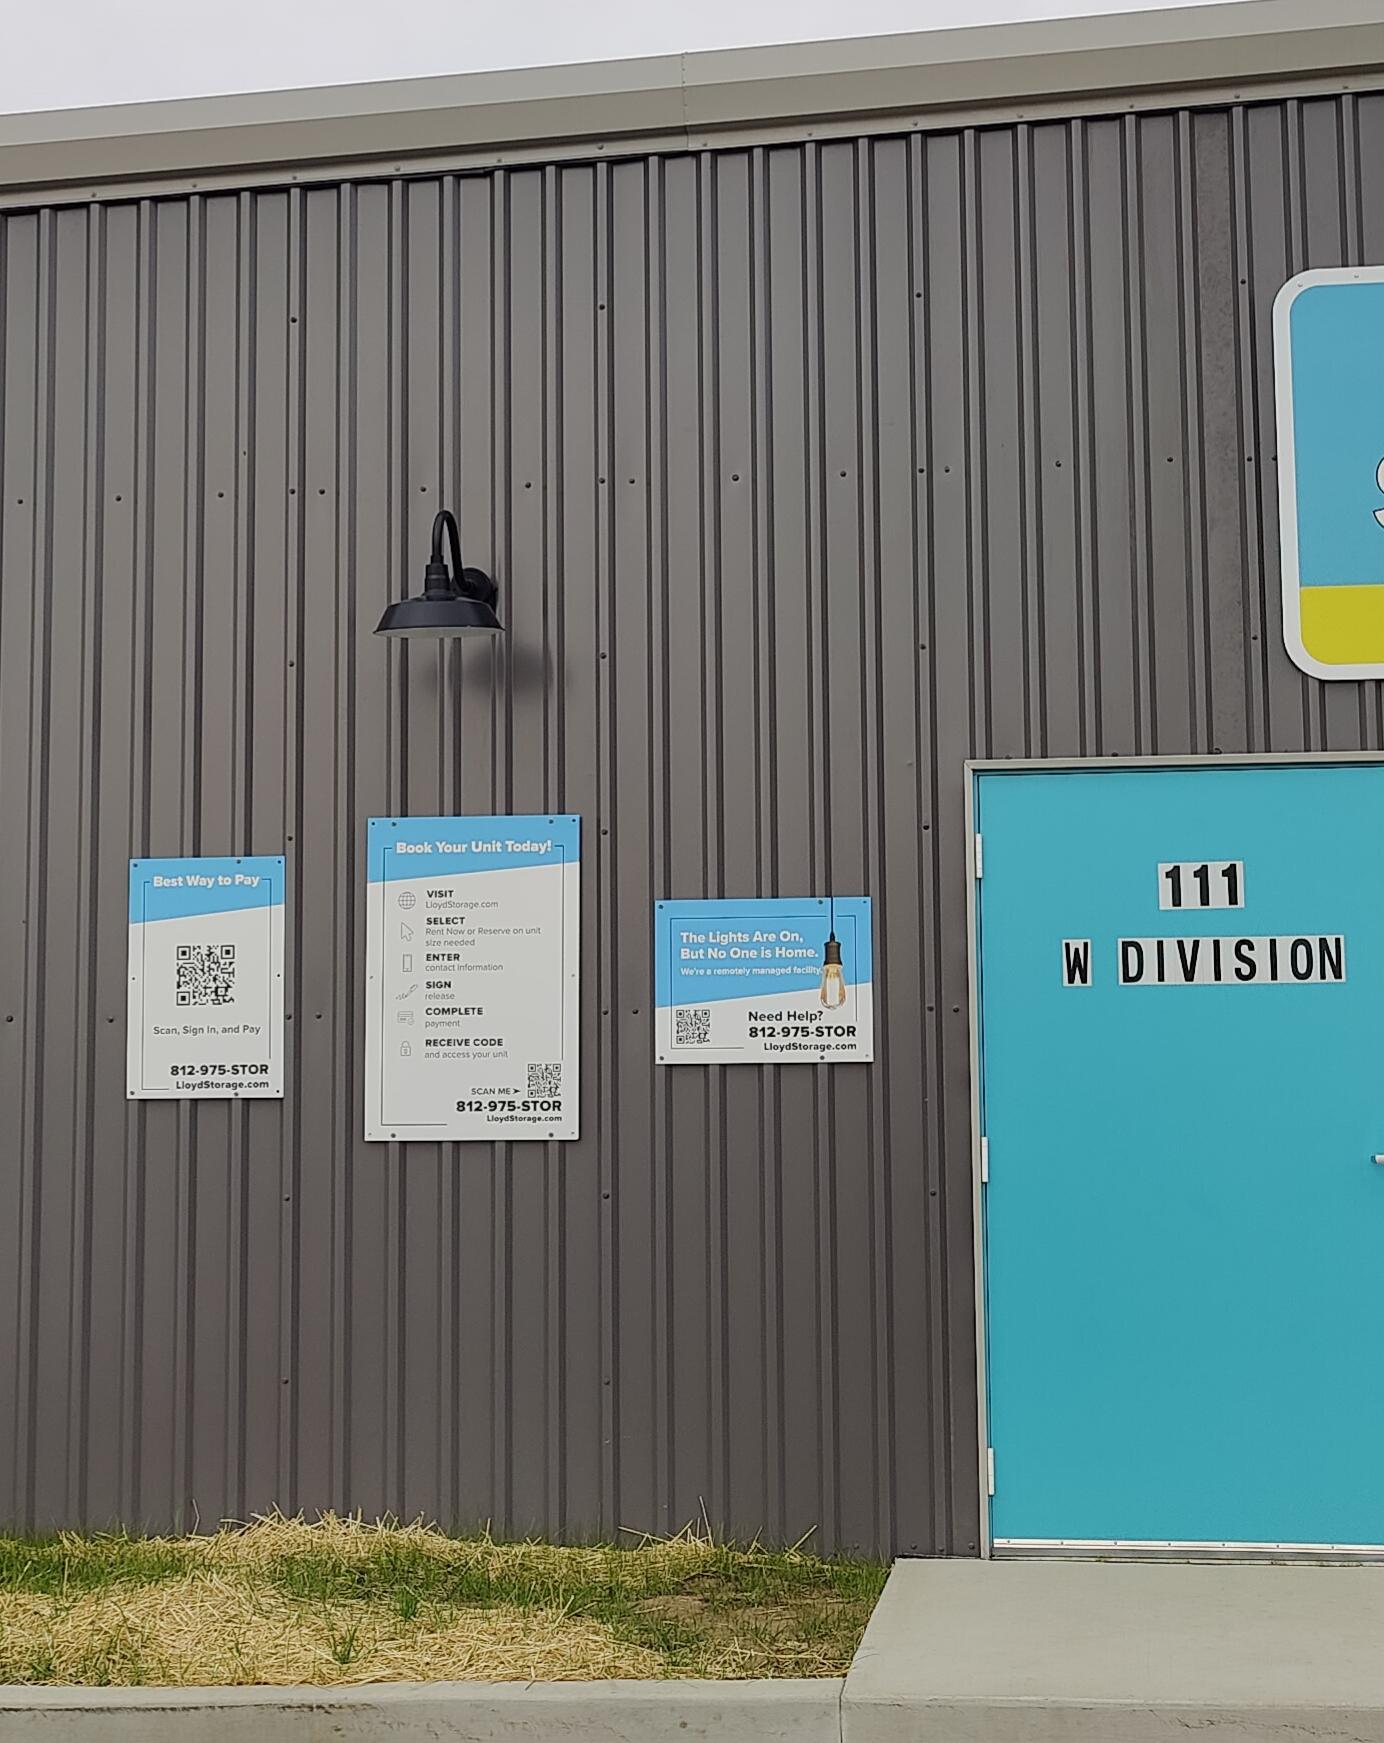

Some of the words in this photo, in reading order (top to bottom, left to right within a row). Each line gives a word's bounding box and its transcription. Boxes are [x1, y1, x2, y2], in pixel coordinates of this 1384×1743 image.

[396, 841, 432, 854] Book
[435, 842, 467, 854] Your
[471, 841, 502, 853] Unit
[505, 841, 552, 853] Today!
[153, 875, 183, 887] Best
[186, 875, 215, 889] Way
[218, 875, 232, 886] to
[235, 874, 259, 887] Pay
[1166, 864, 1238, 907] 111
[427, 890, 454, 898] VISIT
[426, 900, 498, 909] LloydStorage.com
[426, 917, 465, 925] SELECT
[426, 928, 443, 936] Rent
[478, 927, 511, 935] Reserve
[425, 939, 441, 947] size
[443, 938, 475, 946] needed
[680, 932, 705, 943] The
[709, 932, 749, 944] Lights
[753, 932, 776, 942] Are
[779, 931, 803, 943] On,
[681, 948, 704, 959] But
[708, 948, 726, 959] No
[730, 948, 757, 958] One
[761, 947, 771, 957] is
[775, 947, 819, 958] Home.
[1065, 942, 1088, 984] W
[1121, 938, 1342, 983] DIVISION
[456, 963, 503, 971] information
[714, 968, 750, 976] remotely
[752, 968, 791, 976] managed
[426, 981, 452, 989] SIGN
[425, 992, 455, 1000] release
[749, 1011, 782, 1021] Need
[787, 1010, 823, 1022] Help?
[425, 1020, 460, 1029] payment
[153, 1026, 180, 1036] Scan,
[183, 1026, 204, 1036] Sign
[207, 1026, 219, 1034] In,
[221, 1025, 239, 1034] and
[243, 1025, 261, 1034] Pay
[749, 1026, 856, 1037] 812-975-STOR
[425, 1039, 470, 1047] RECEIVE
[474, 1038, 503, 1046] CODE
[764, 1042, 856, 1052] LloydStorage.com
[425, 1051, 439, 1059] and
[472, 1051, 489, 1060] your
[492, 1050, 508, 1058] unit
[171, 1065, 268, 1076] 812-975-STOR
[176, 1080, 269, 1090] LloydStorage.com
[456, 1101, 561, 1112] 812-975-STOR
[487, 1115, 562, 1123] LloydStorage.com
